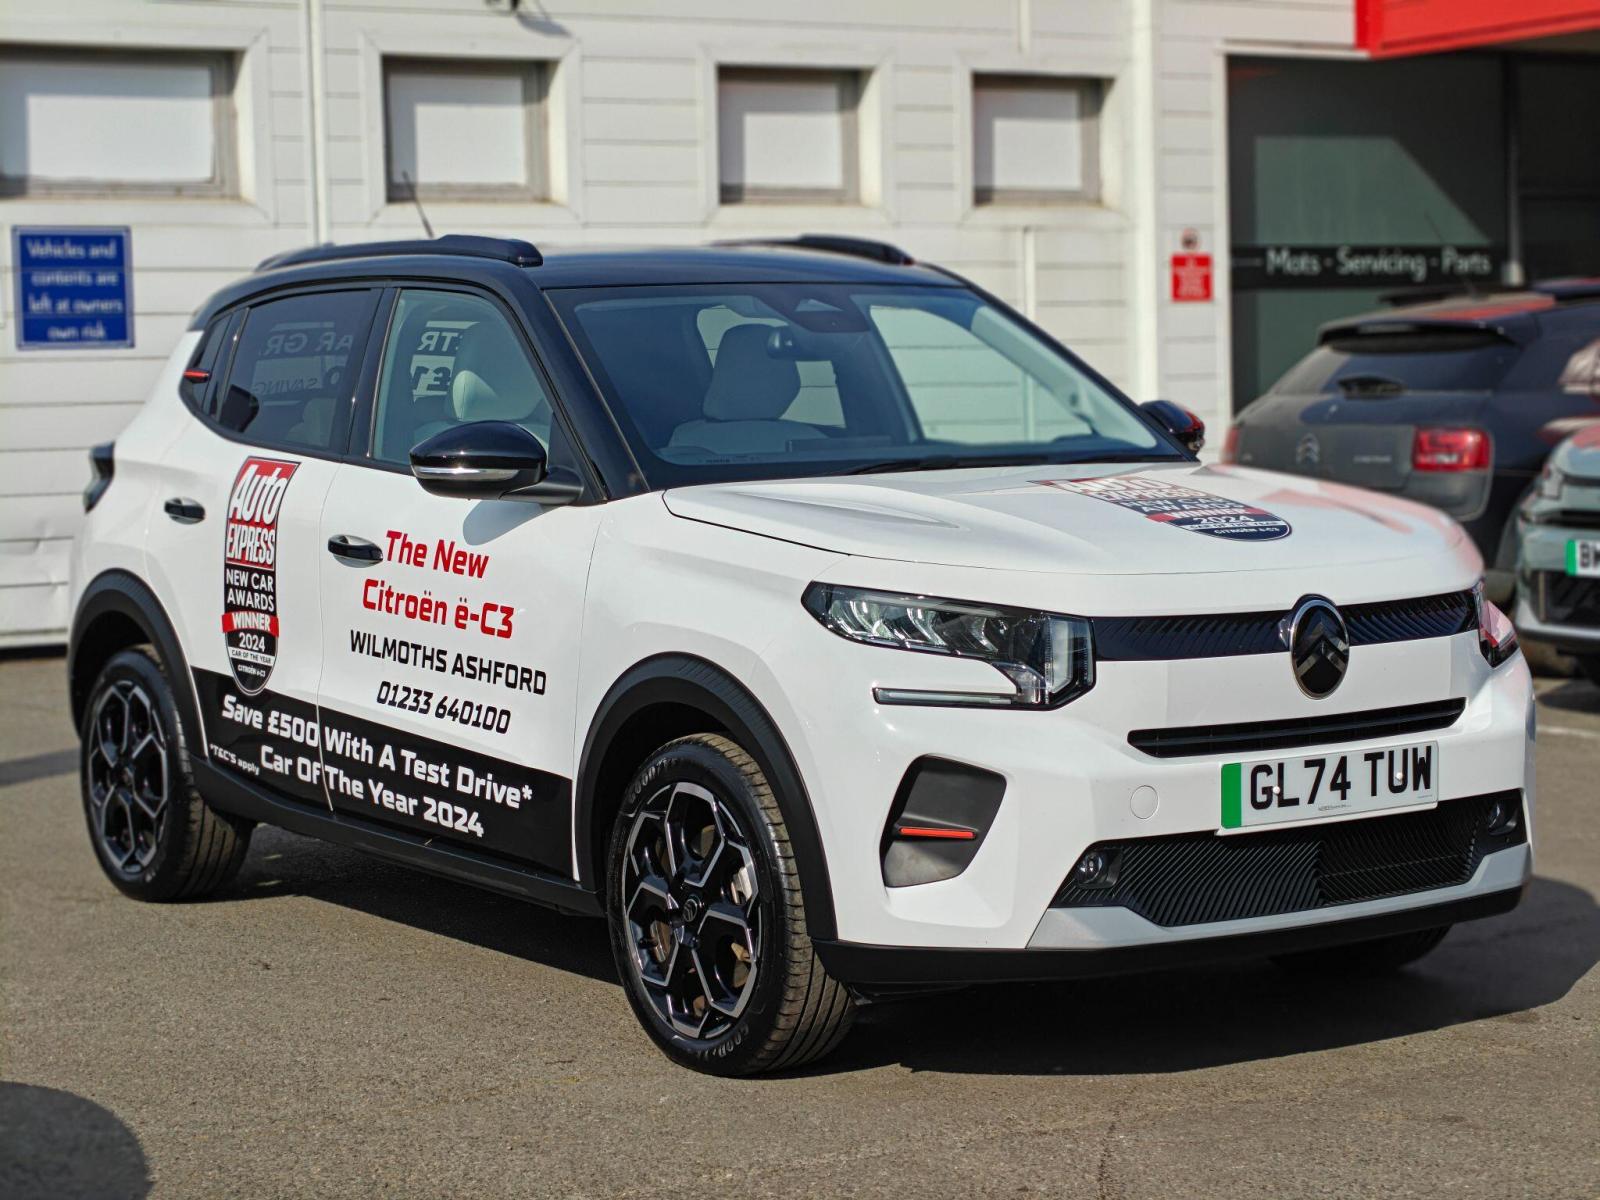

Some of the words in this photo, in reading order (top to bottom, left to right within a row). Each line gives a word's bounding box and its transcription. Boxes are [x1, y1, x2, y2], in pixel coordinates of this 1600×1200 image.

[26, 238, 86, 259] Vehicles
[89, 239, 117, 259] and
[31, 271, 92, 287] contents
[96, 272, 120, 287] are
[1267, 248, 1322, 276] Mots
[1336, 246, 1428, 283] Servicing
[1442, 247, 1493, 276] Parts
[28, 291, 51, 314] left
[56, 299, 70, 313] at
[73, 299, 123, 314] owners
[47, 326, 79, 340] own
[82, 320, 107, 339] risk
[228, 464, 289, 525] Auto
[226, 522, 276, 565] EXPRESS
[385, 529, 428, 568] The
[433, 539, 490, 578] New
[226, 568, 249, 587] NEW
[251, 572, 274, 592] CAR
[227, 588, 275, 612] AWARDS
[362, 578, 448, 625] Citroën
[454, 597, 515, 639] ë-C3
[234, 612, 271, 632] WINNER
[231, 649, 242, 657] CAR
[250, 653, 259, 661] THE
[239, 632, 266, 652] 2024
[350, 629, 448, 673] WILMOTHS
[451, 653, 547, 695] ASHFORD
[376, 681, 434, 715] 01233
[435, 695, 511, 734] 640100
[222, 694, 263, 730] Save
[267, 710, 320, 748] £500
[324, 726, 373, 764] With
[378, 744, 396, 771] A
[401, 749, 450, 788] Test
[238, 758, 260, 776] apply
[1250, 755, 1352, 811] GL74
[1363, 745, 1432, 797] TUW
[261, 744, 293, 775] Car
[324, 765, 364, 799] The
[368, 778, 418, 816] Year
[423, 796, 485, 838] 2024
